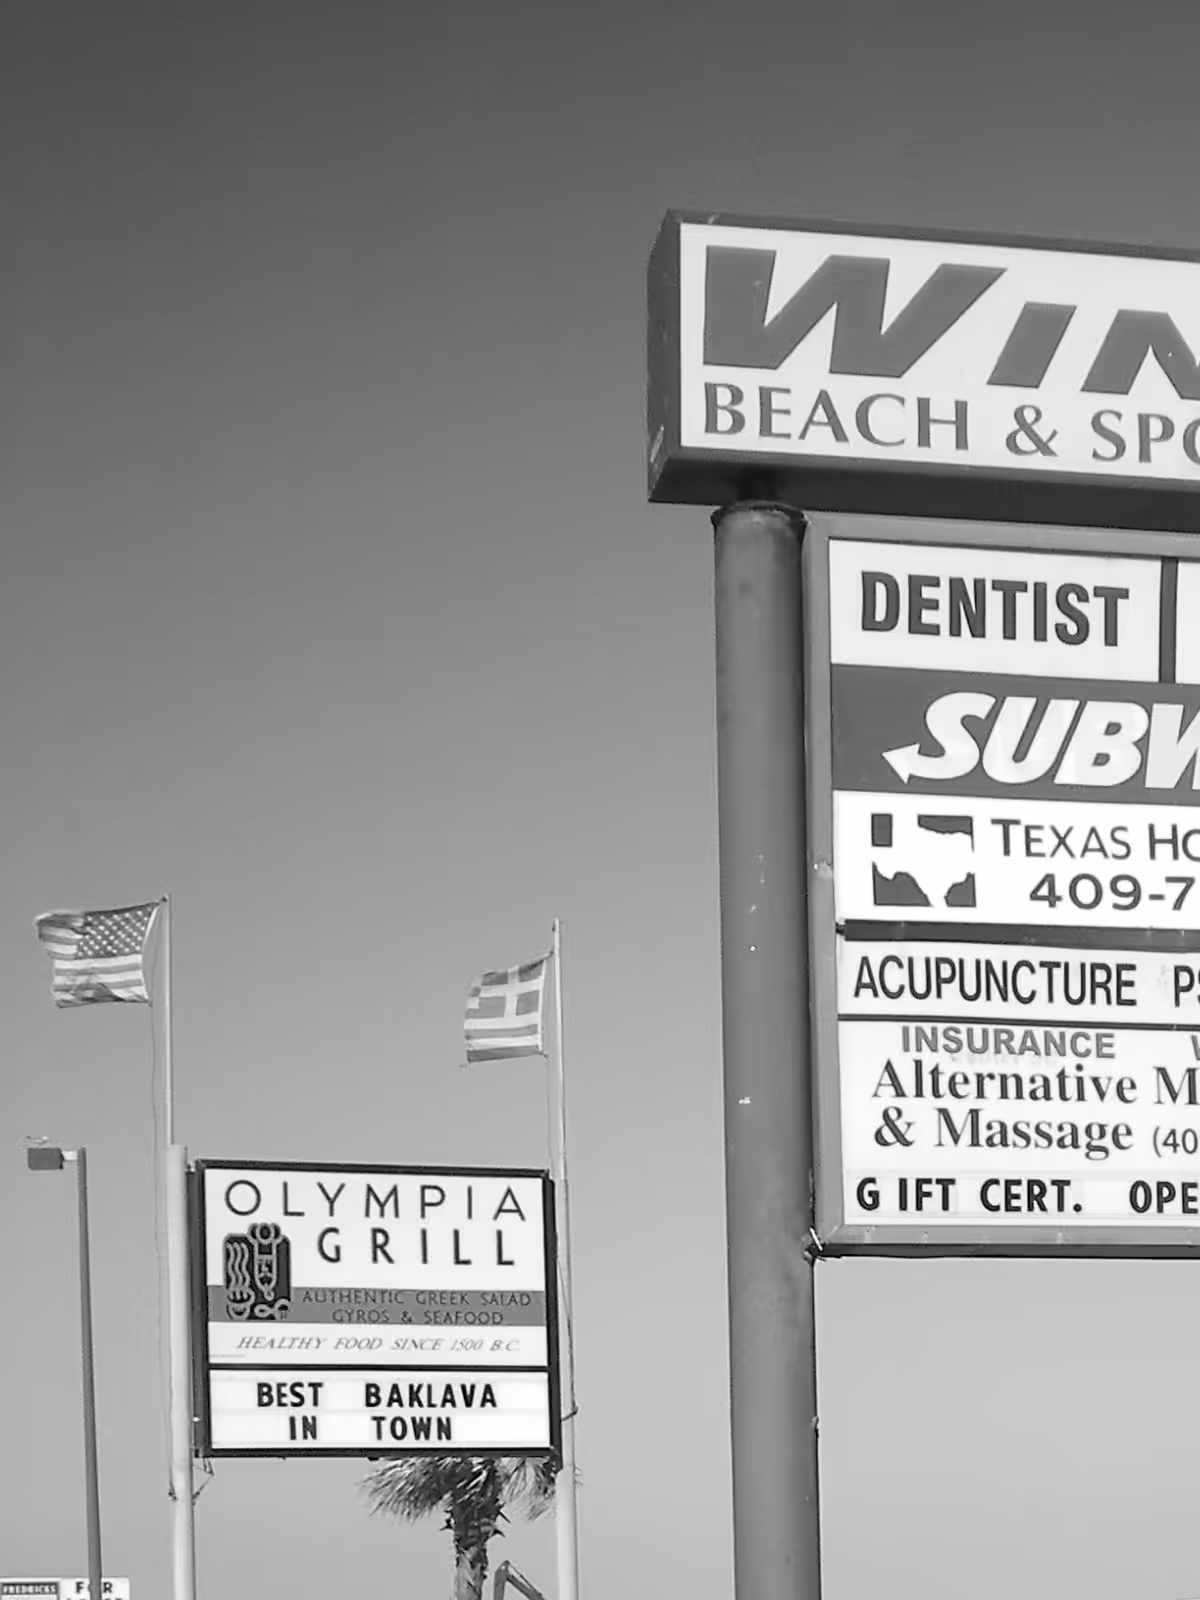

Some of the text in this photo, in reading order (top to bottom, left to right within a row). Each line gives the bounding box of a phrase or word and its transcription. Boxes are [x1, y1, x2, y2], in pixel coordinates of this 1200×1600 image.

[704, 381, 969, 452] BEACH
[1006, 404, 1059, 458] &
[860, 570, 1130, 648] DENTIST
[990, 817, 1132, 861] TEXAS
[853, 954, 1138, 1007] ACUPUNCTURE
[901, 1025, 1117, 1059] INSURANCE
[871, 1059, 1139, 1104] Alternative
[873, 1105, 1135, 1161] & Massage
[224, 1179, 526, 1222] OLYMPIA
[979, 1178, 1084, 1215] CERT.
[317, 1226, 516, 1267] GRILL
[301, 1288, 532, 1307] AUTHENTIC GREEK SALAD
[331, 1308, 505, 1326] GYROS & SEAFOOD
[236, 1335, 326, 1351] HEALTHY
[334, 1336, 383, 1352] FOOD
[390, 1337, 444, 1352] SINCE
[450, 1338, 484, 1352] 1500
[256, 1381, 499, 1409] BEST BAKLAVA
[289, 1415, 453, 1441] IN TOWN
[75, 1581, 114, 1594] FR
